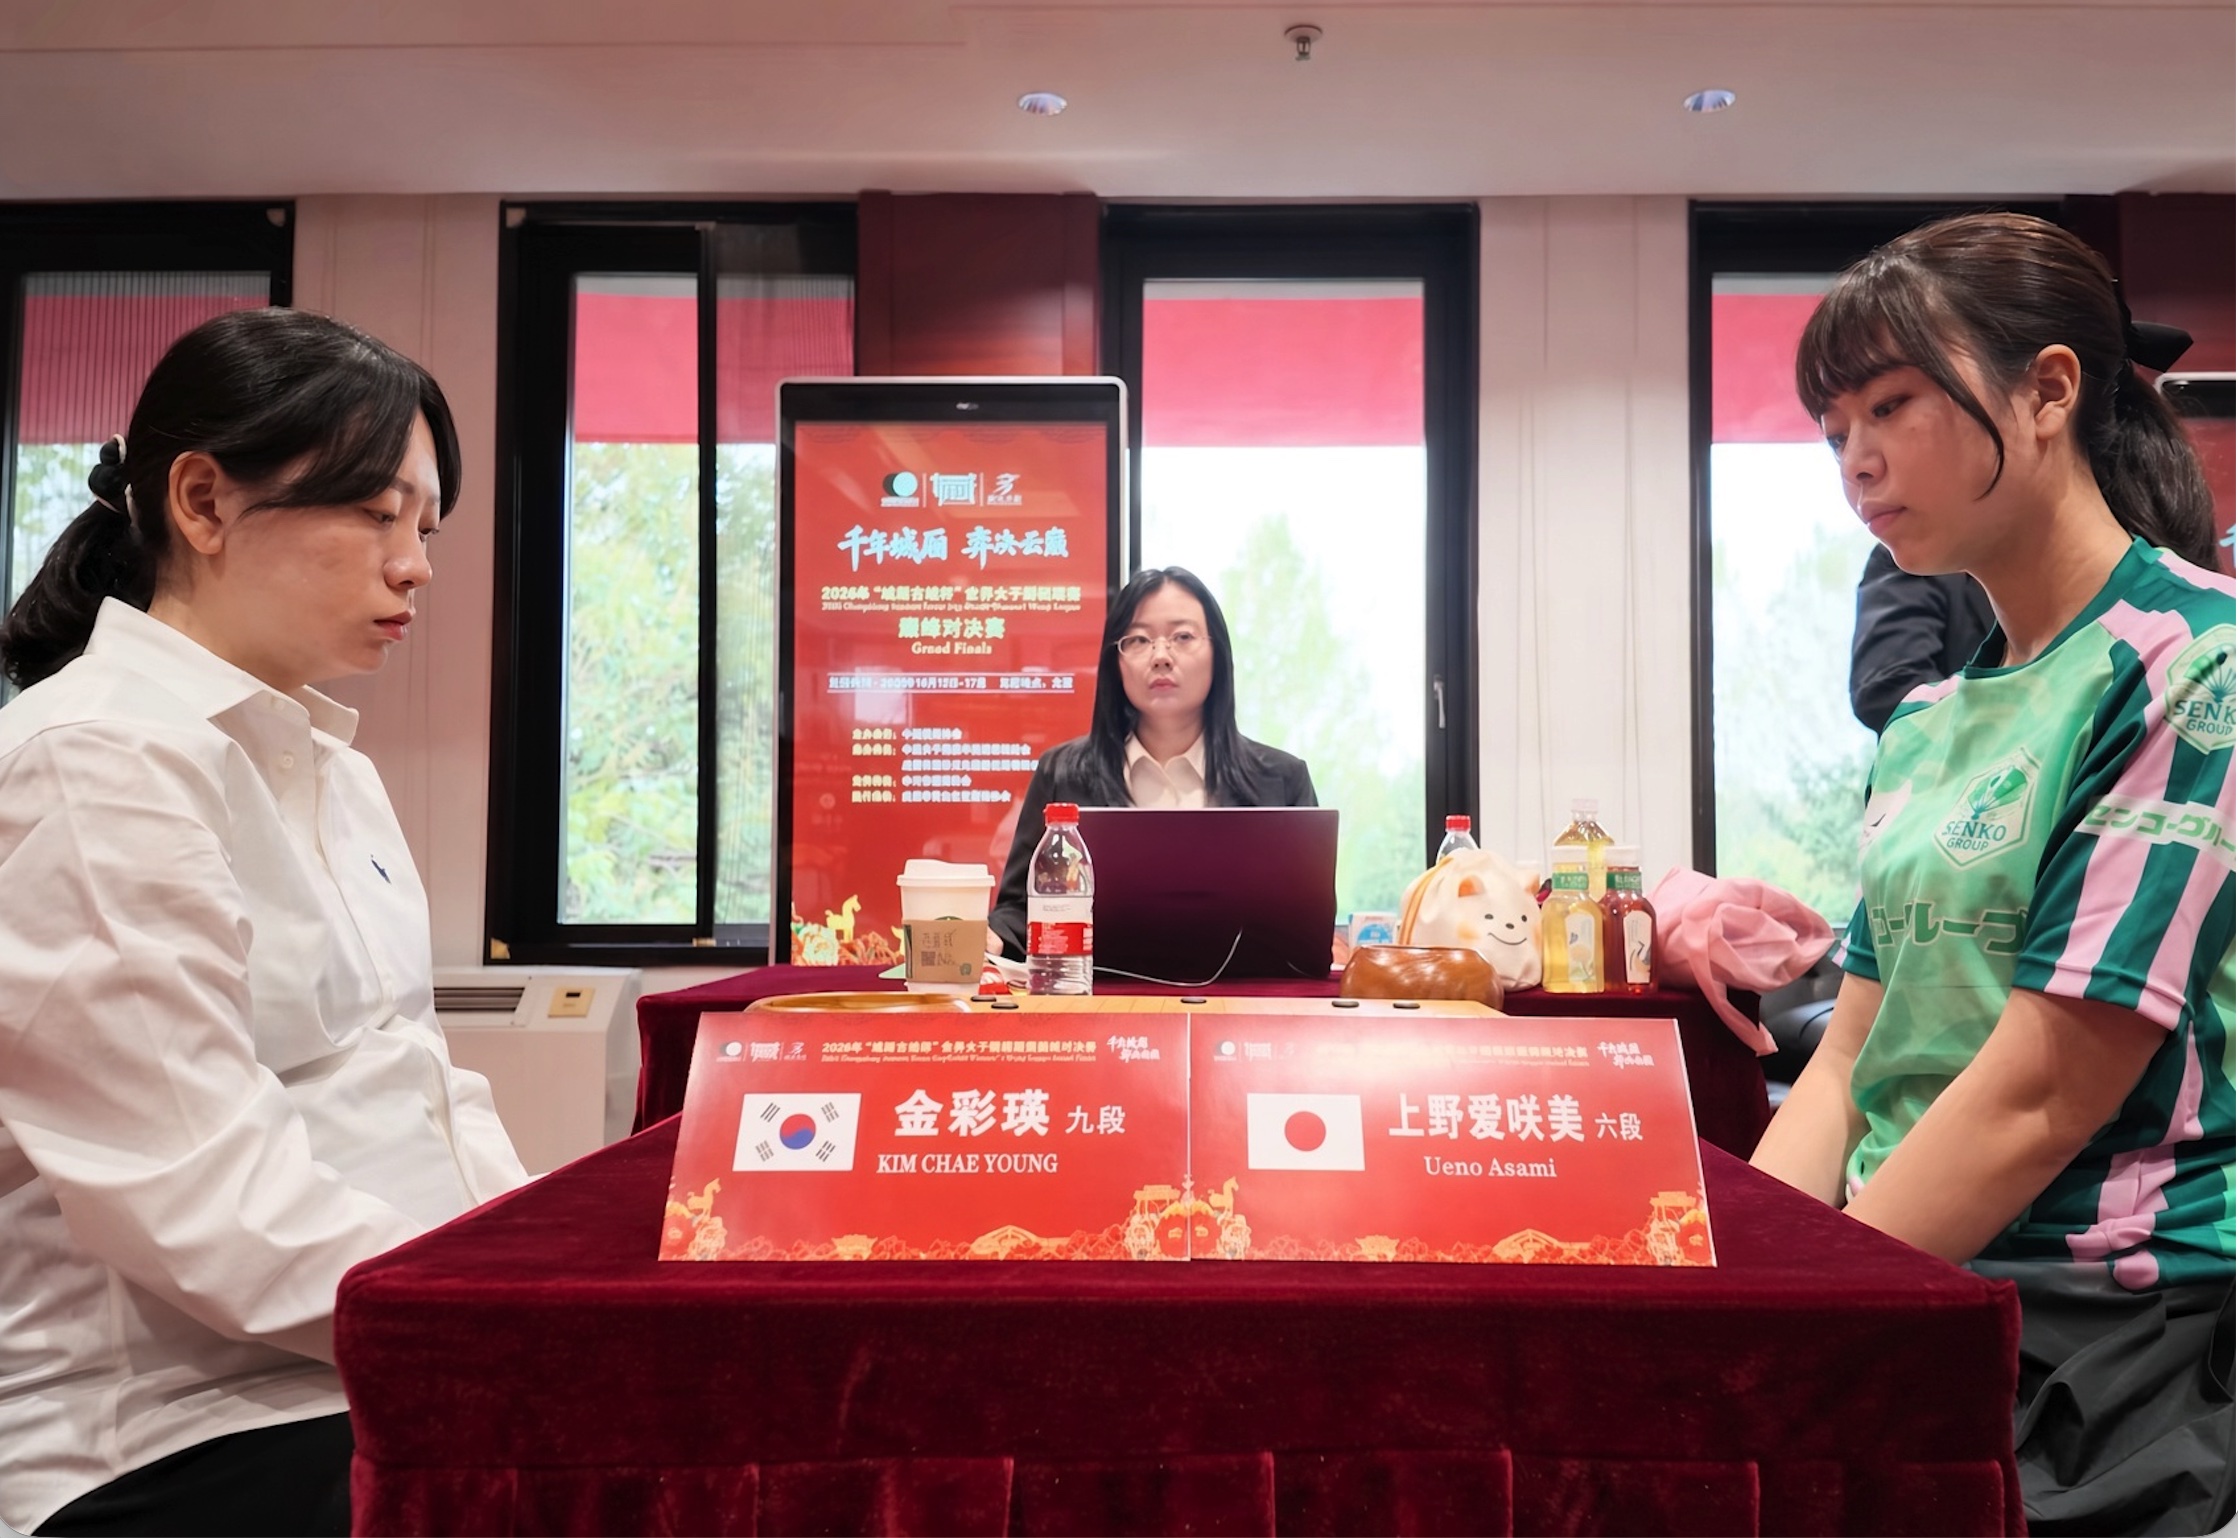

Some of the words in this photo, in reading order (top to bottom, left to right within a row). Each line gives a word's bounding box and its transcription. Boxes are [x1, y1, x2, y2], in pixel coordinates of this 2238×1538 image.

[1941, 820, 2007, 841] SENKO
[1946, 837, 1989, 851] GROUP
[894, 1088, 1050, 1137] 金彩瑛
[1065, 1105, 1126, 1135] 九段
[1388, 1092, 1585, 1142] 上野爱咲美
[1595, 1112, 1643, 1141] 六段
[876, 1153, 918, 1173] KIM
[921, 1153, 979, 1173] CHAE
[984, 1153, 1058, 1173] YOUNG
[1424, 1156, 1482, 1176] Ueno
[1488, 1157, 1557, 1177] Asami
